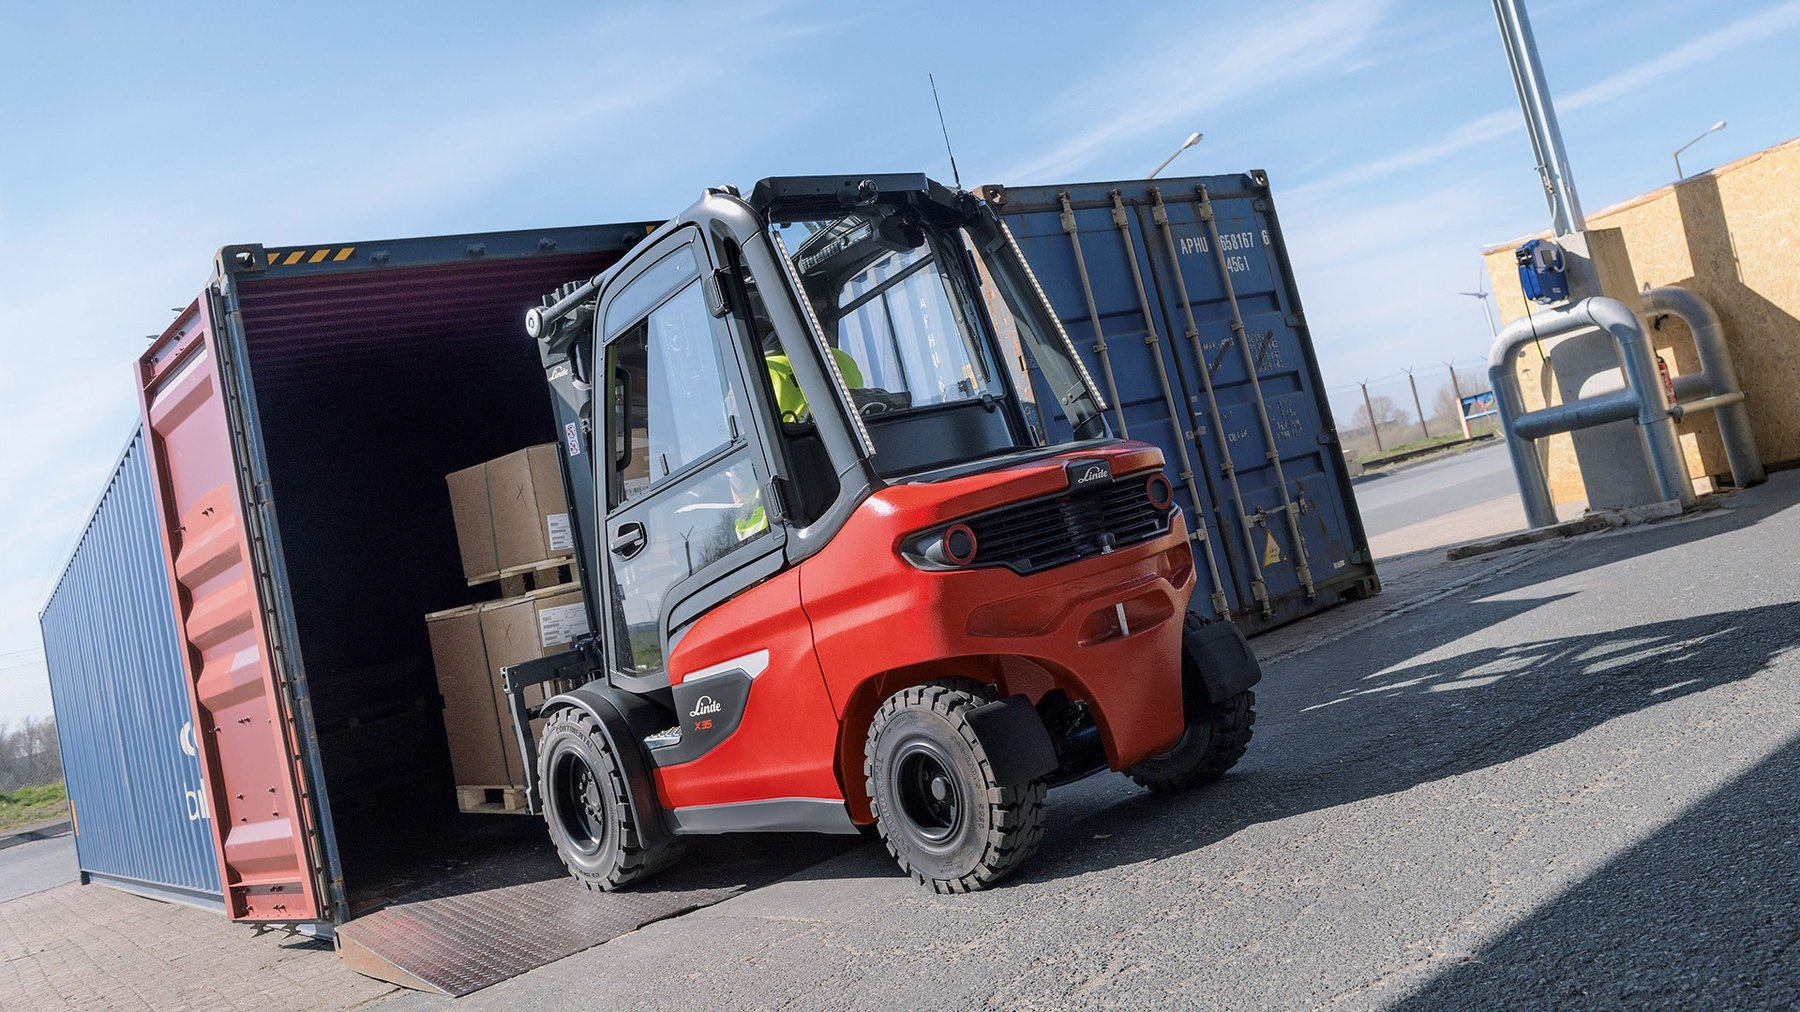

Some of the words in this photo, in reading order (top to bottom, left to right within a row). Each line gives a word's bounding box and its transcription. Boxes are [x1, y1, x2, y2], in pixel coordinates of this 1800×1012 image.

[1180, 236, 1209, 255] APHU
[1219, 231, 1254, 251] 658167
[1261, 229, 1270, 245] 6
[1226, 255, 1250, 273] 45G1
[548, 365, 568, 381] Linde
[1077, 466, 1109, 484] Linde
[689, 695, 722, 718] Linde
[556, 725, 593, 753] CONTINENTAL
